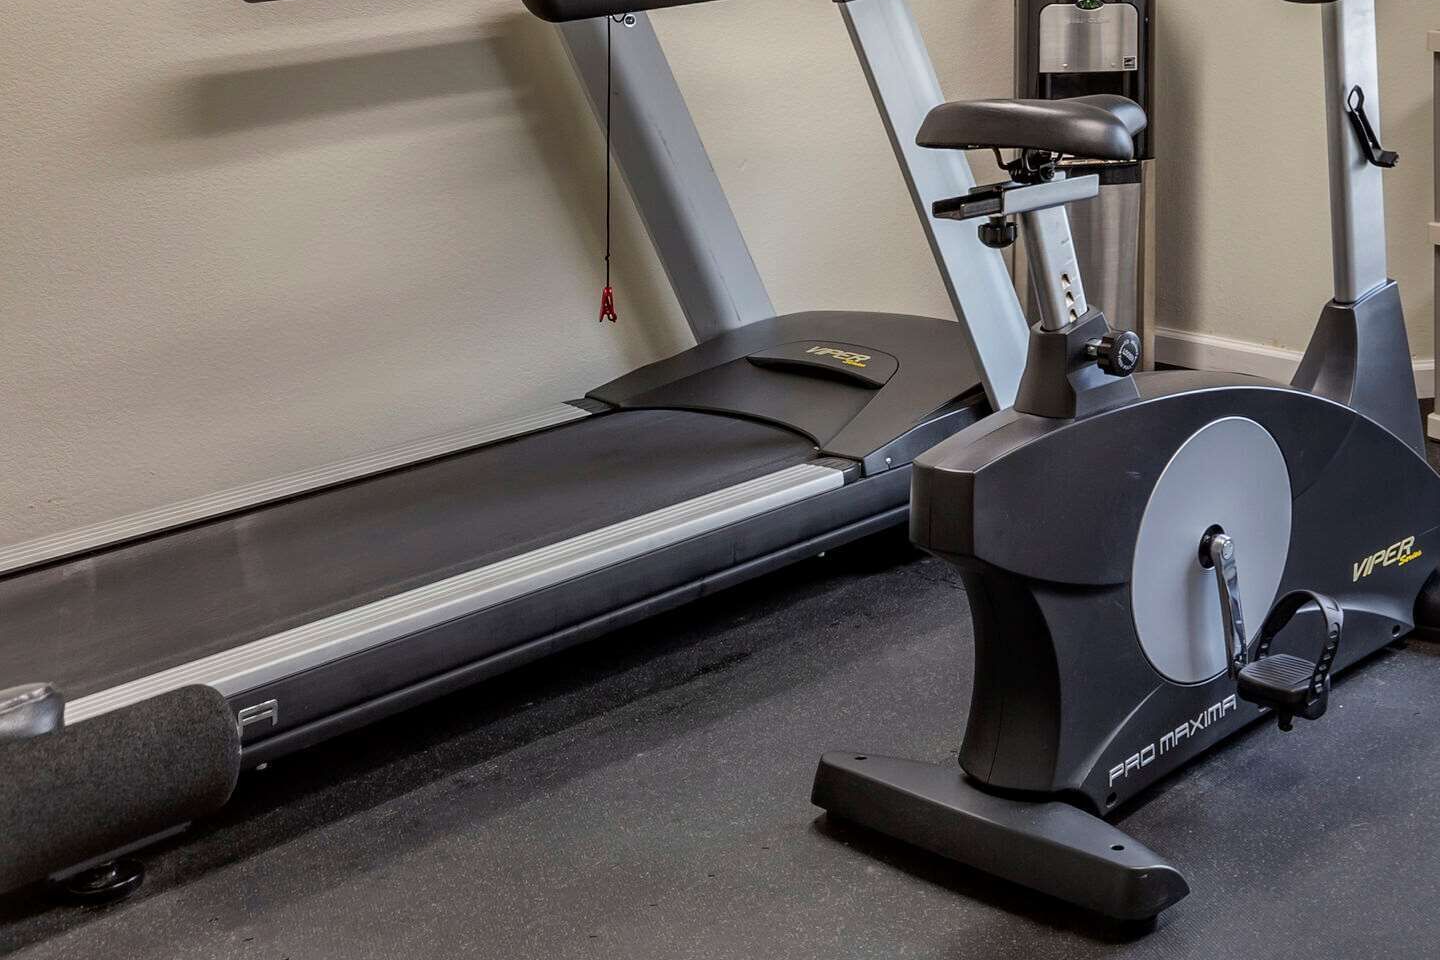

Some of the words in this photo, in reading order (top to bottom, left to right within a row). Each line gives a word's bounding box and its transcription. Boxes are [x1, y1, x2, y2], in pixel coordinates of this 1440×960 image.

[805, 345, 871, 362] VIPER
[1352, 535, 1415, 582] VIPER
[1108, 743, 1156, 788] PRO
[1159, 693, 1237, 756] MAXIMA
